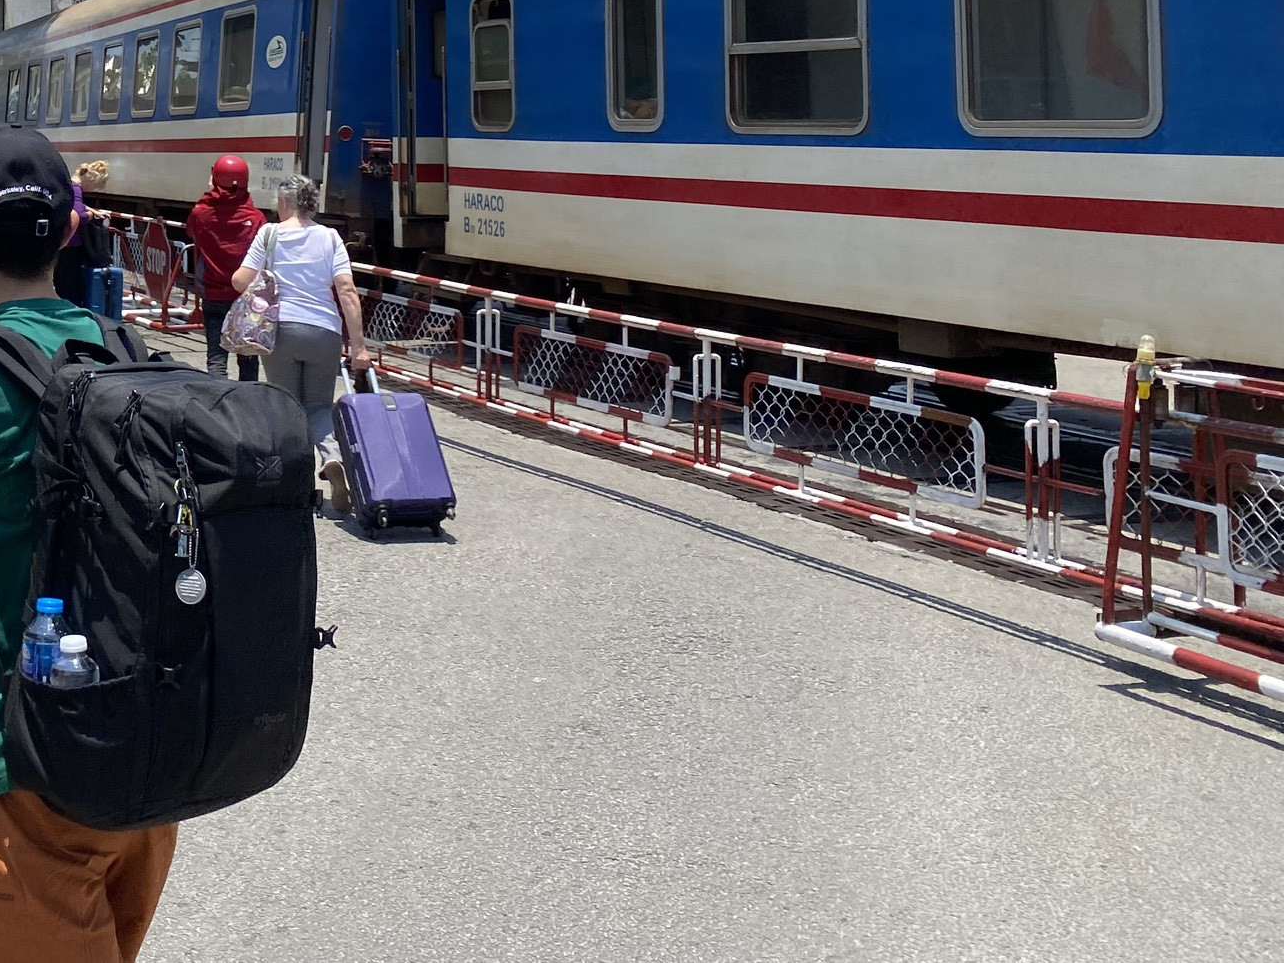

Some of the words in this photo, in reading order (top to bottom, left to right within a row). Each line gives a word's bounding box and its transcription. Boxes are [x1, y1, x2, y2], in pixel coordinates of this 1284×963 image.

[463, 192, 504, 212] HARACO
[477, 218, 506, 237] 21526
[146, 246, 166, 276] STOP
